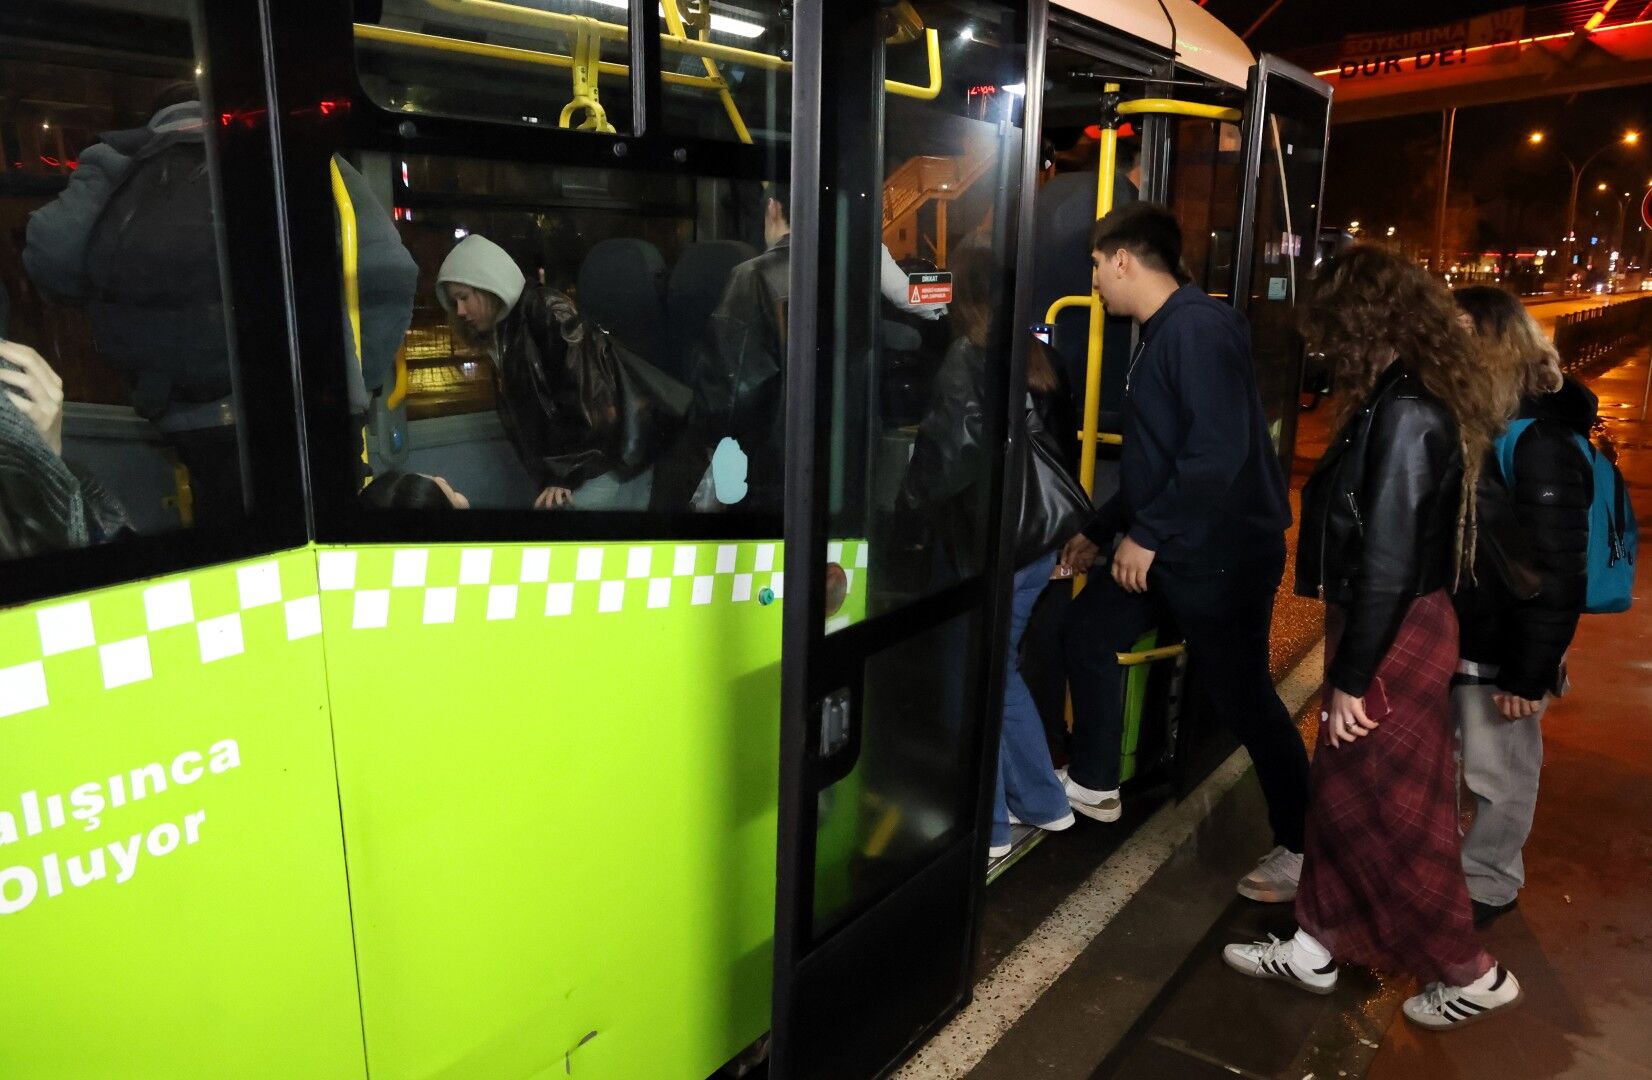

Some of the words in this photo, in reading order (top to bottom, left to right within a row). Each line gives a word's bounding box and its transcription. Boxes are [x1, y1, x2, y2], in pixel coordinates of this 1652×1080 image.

[1339, 54, 1402, 79] DUR
[1415, 44, 1467, 70] DE!
[0, 809, 206, 915] Oluyor
